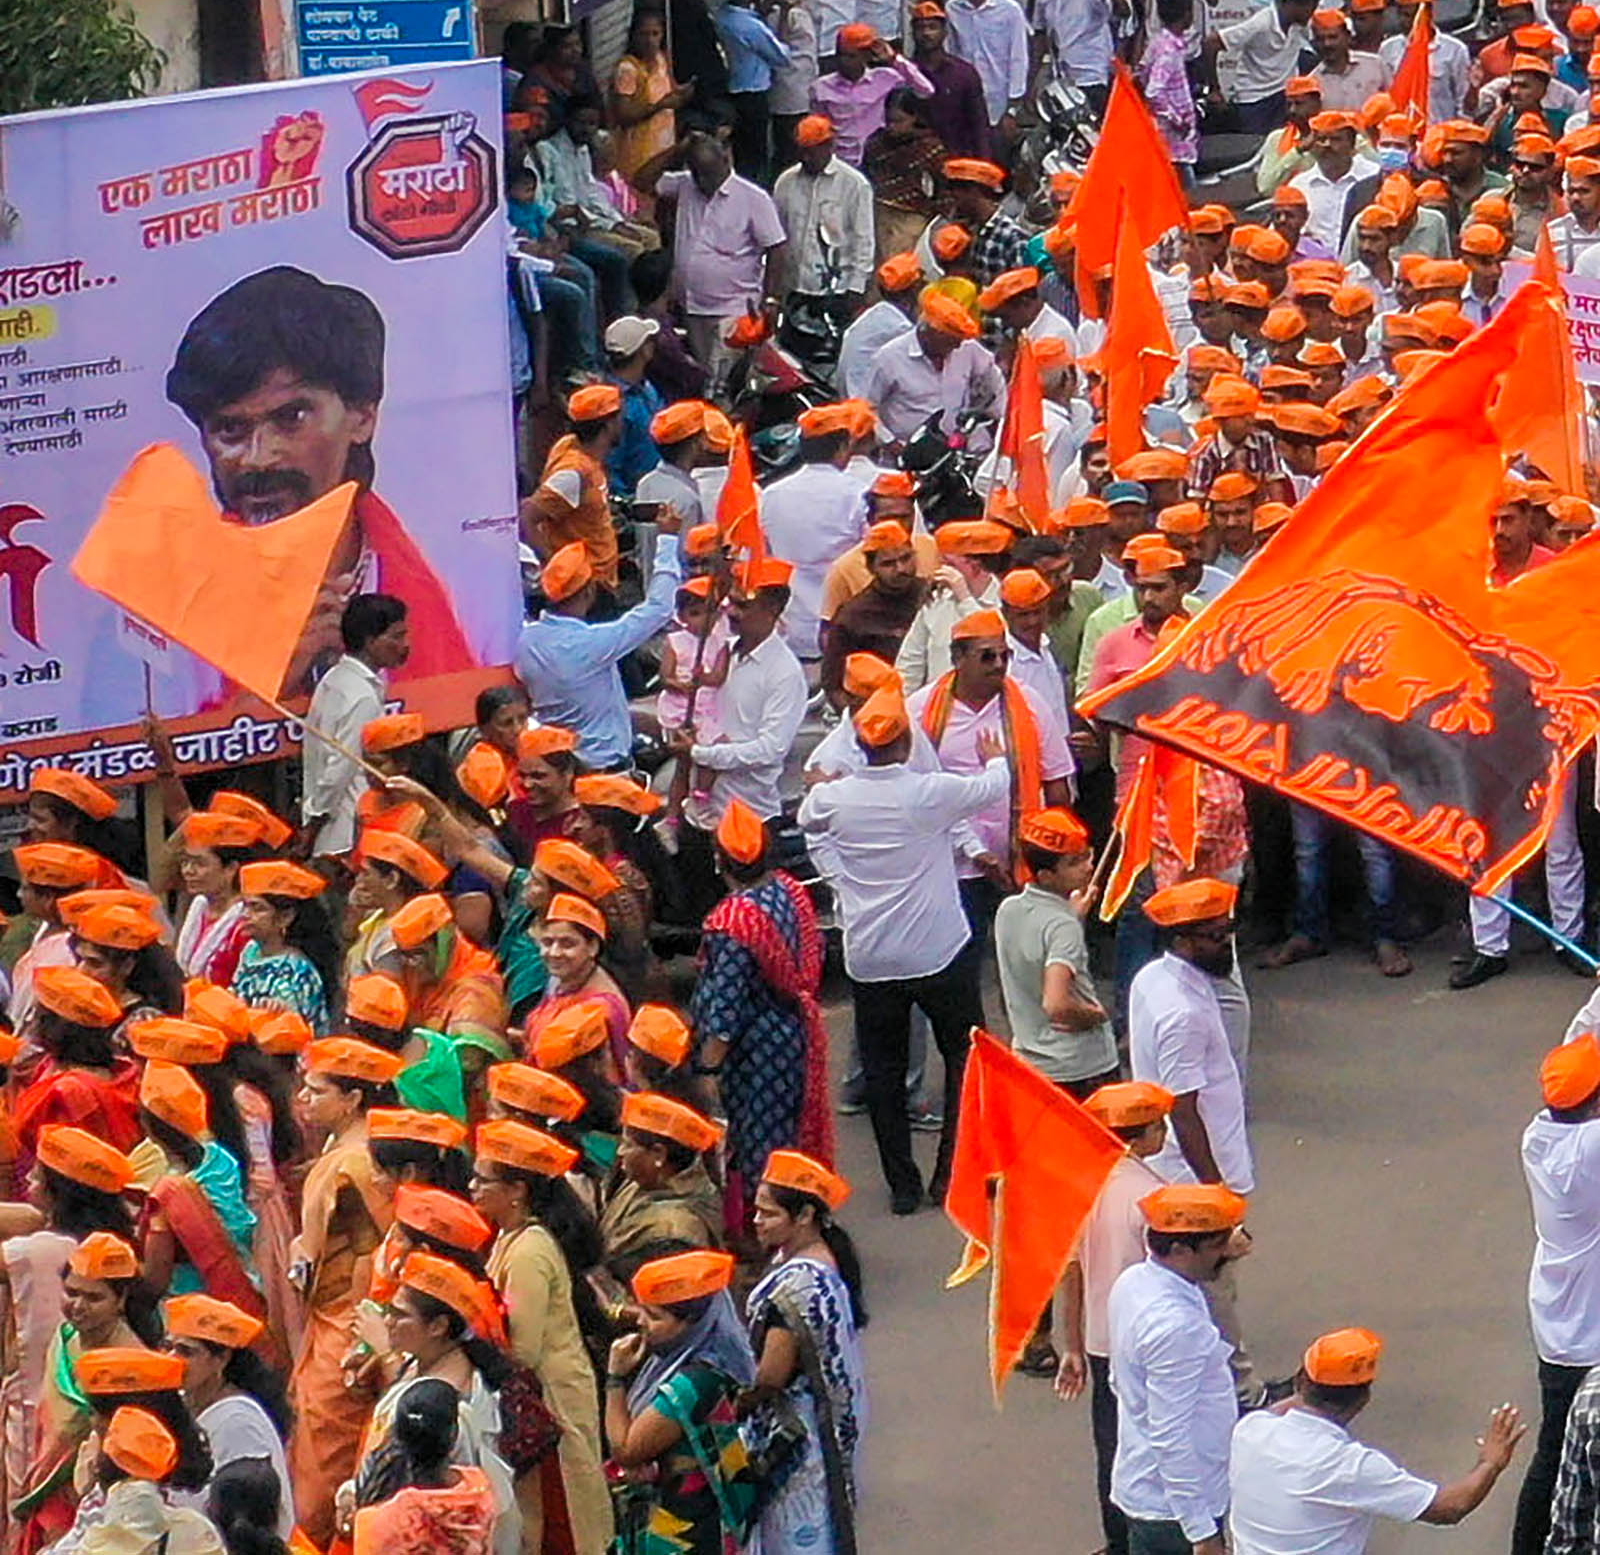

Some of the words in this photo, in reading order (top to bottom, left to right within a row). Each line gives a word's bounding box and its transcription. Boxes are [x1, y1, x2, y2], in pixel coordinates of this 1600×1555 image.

[99, 174, 153, 214] एक
[161, 147, 254, 197] मराठा
[378, 158, 470, 201] मराठा
[140, 199, 223, 250] लाख
[231, 176, 322, 227] मराठा
[13, 661, 62, 686] रोजी
[1, 716, 58, 739] कराड
[173, 715, 279, 764] जाहीर
